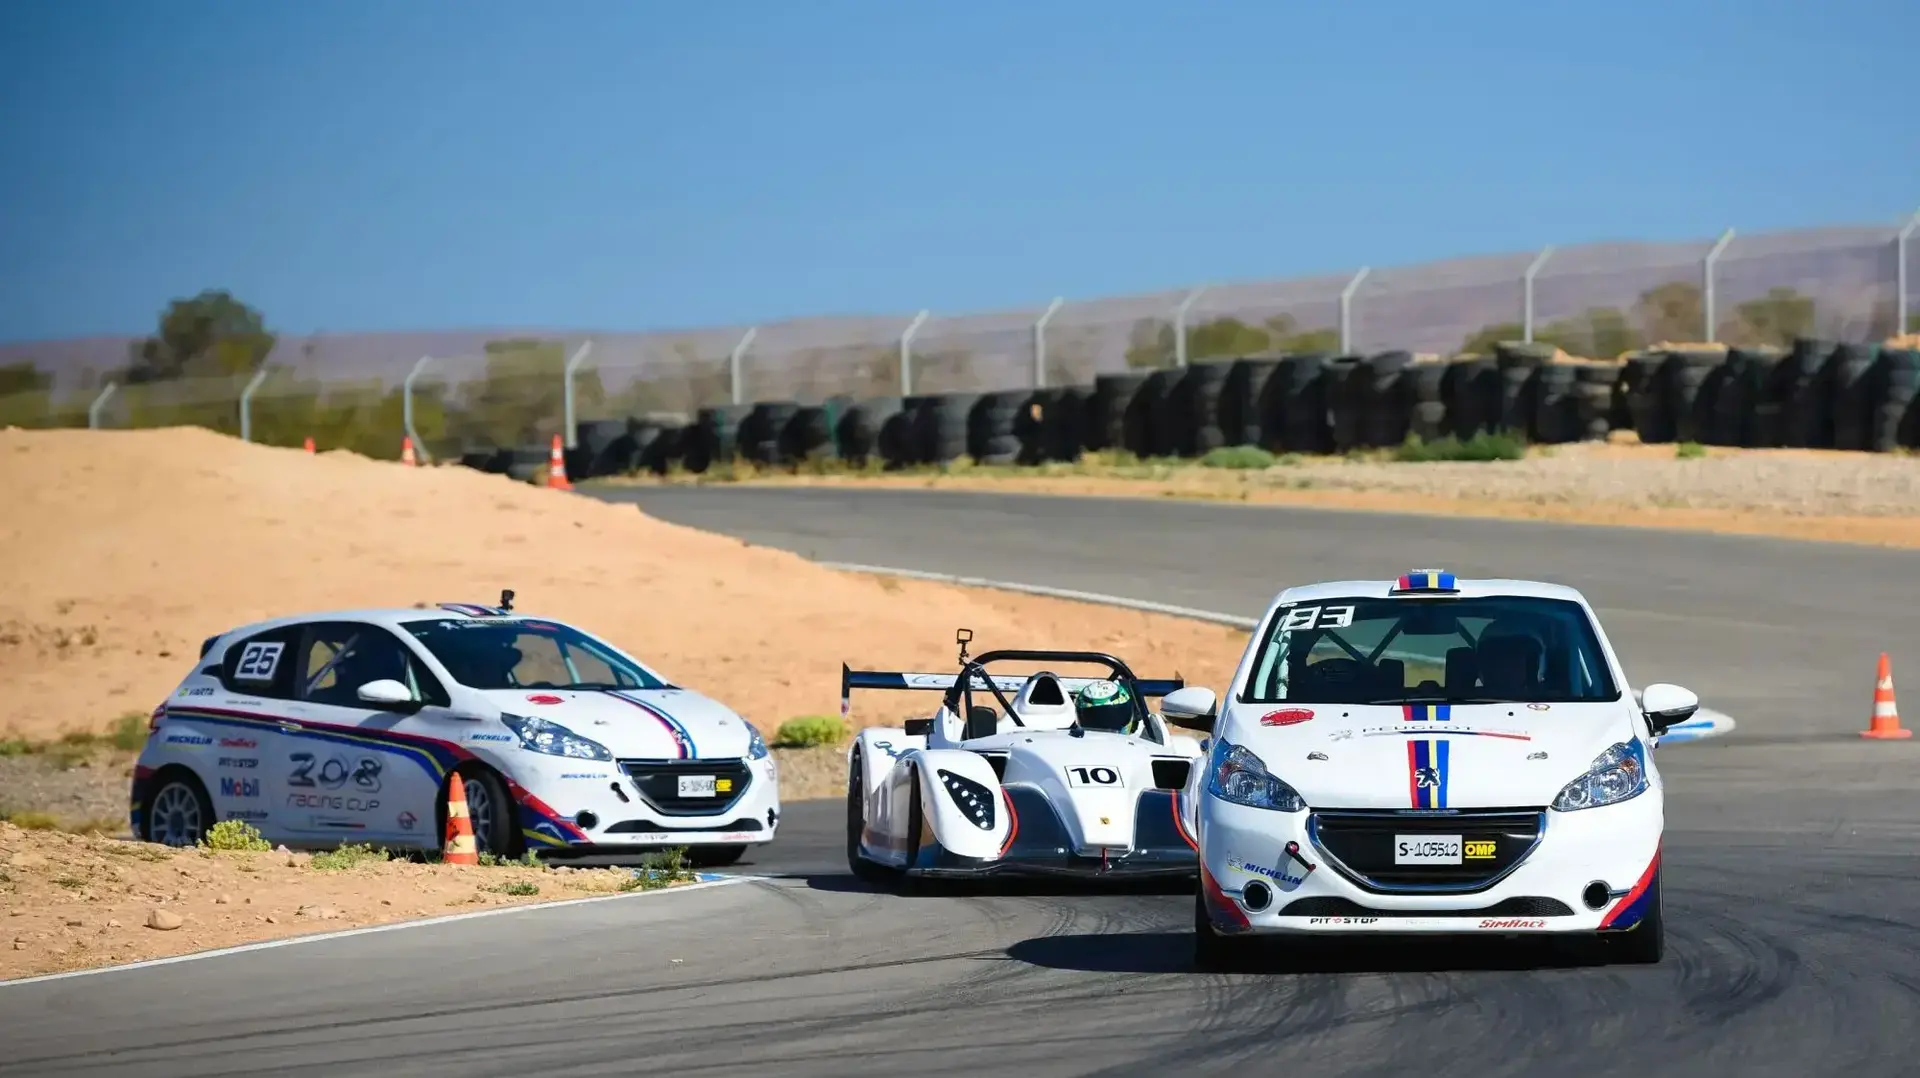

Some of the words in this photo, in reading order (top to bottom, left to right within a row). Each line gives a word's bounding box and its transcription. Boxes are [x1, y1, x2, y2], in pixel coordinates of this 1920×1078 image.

[239, 646, 279, 675] 25
[167, 735, 213, 744] MICHELIN
[288, 753, 382, 793] 208
[1070, 767, 1117, 785] 10
[221, 777, 259, 797] Mobil
[1464, 844, 1496, 856] OMP
[1244, 863, 1303, 885] MICHELIN
[1310, 917, 1331, 925] PIT
